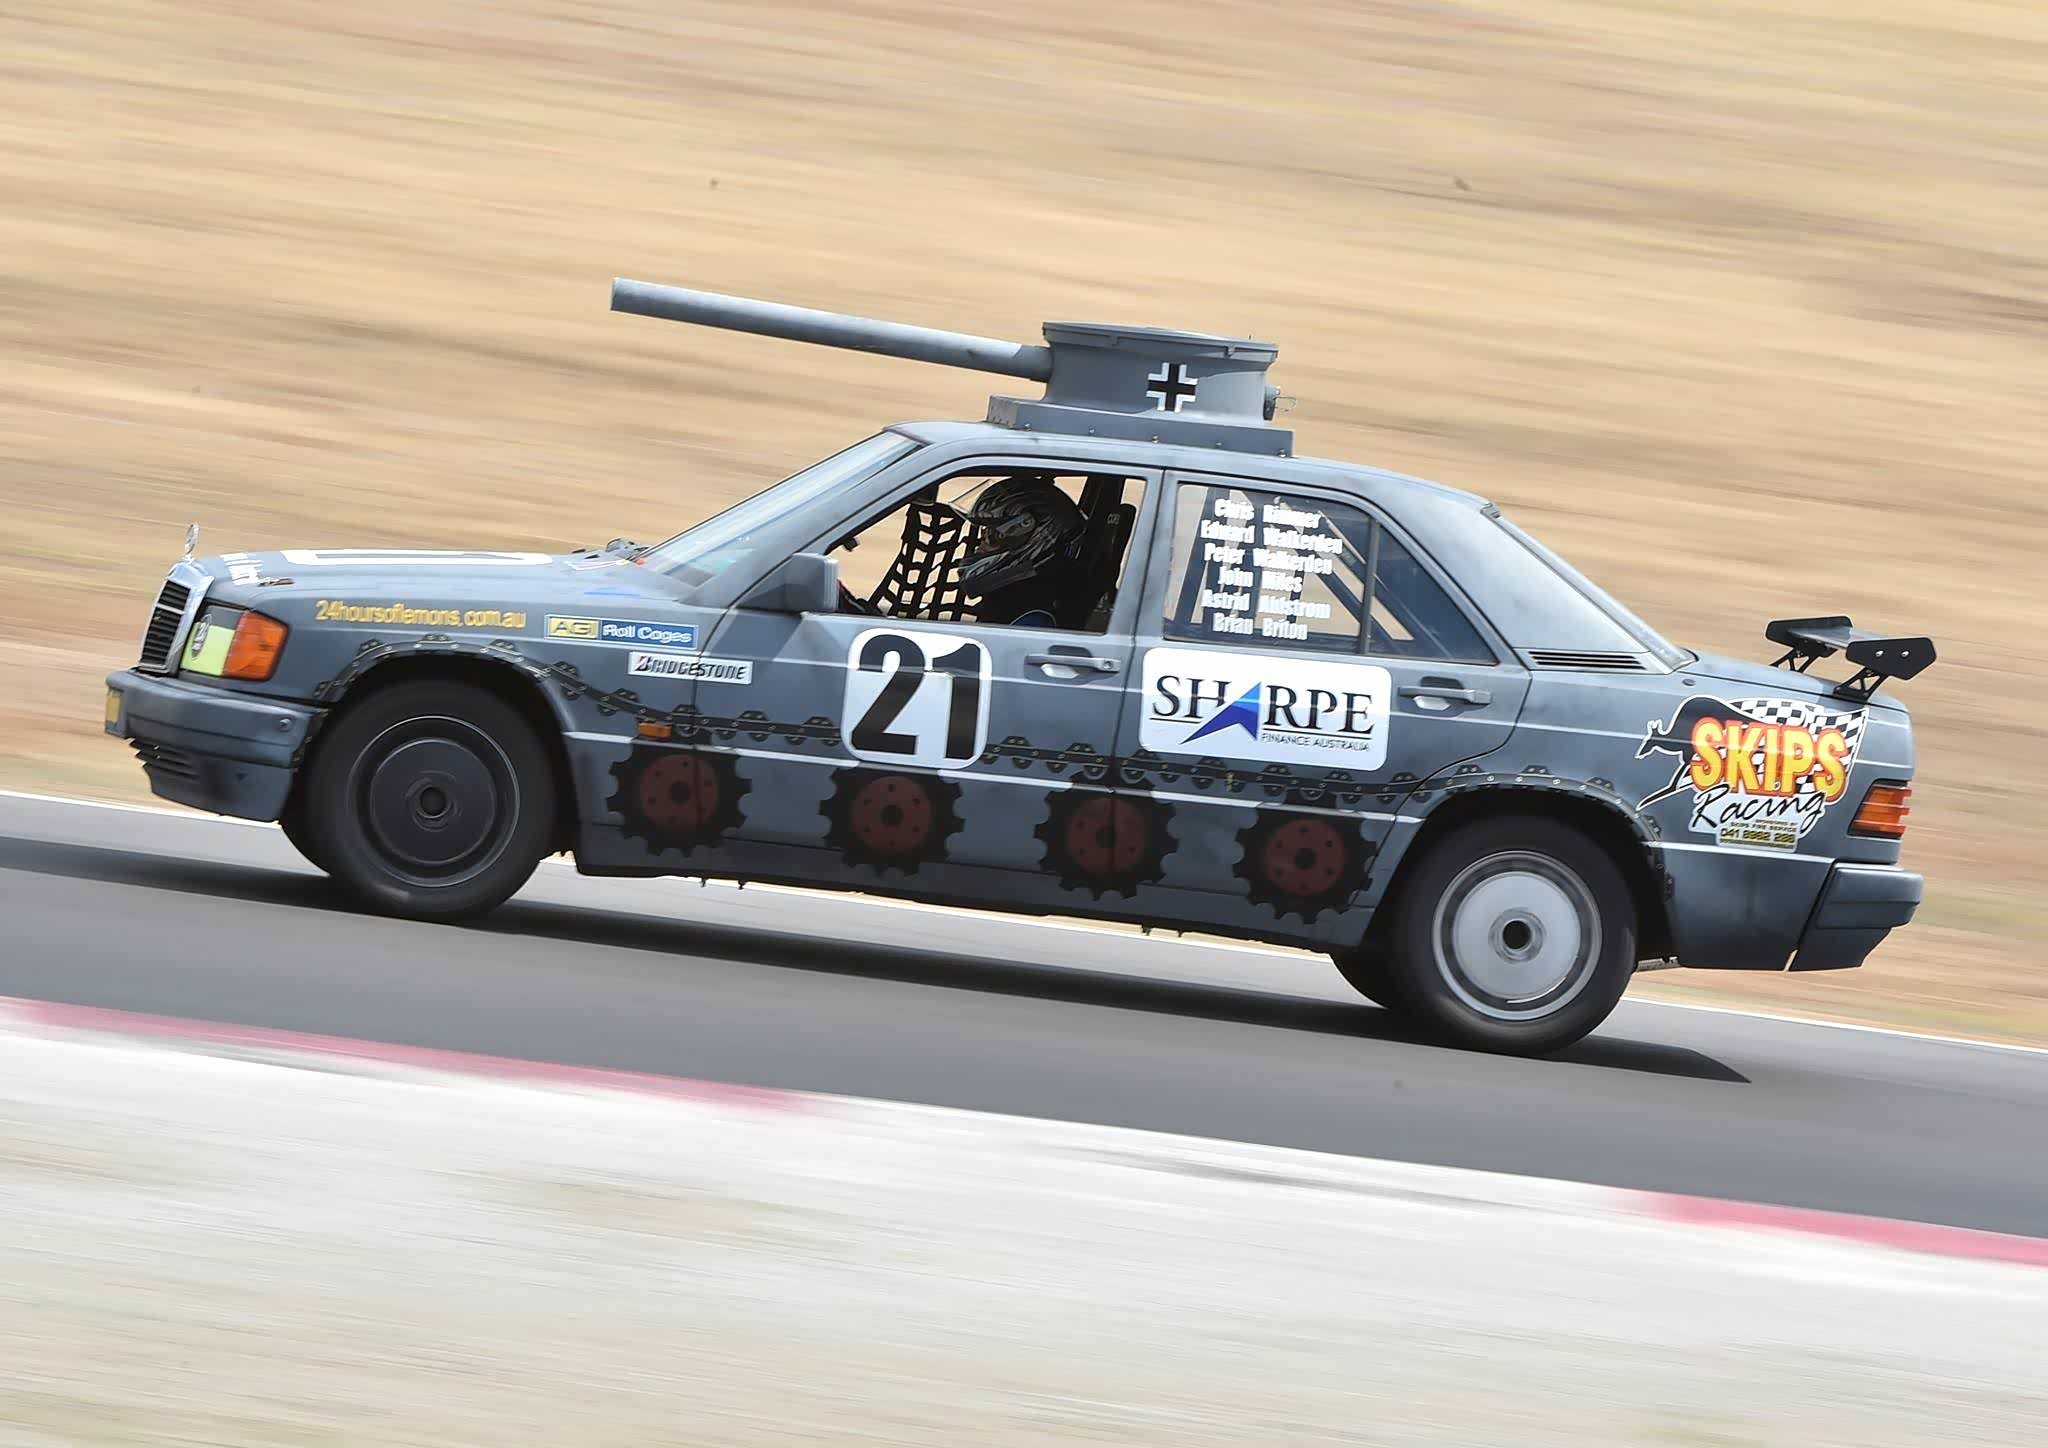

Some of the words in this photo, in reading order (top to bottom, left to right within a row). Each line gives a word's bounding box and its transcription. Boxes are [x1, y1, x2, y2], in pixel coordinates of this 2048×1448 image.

[1204, 543, 1245, 564] Peter
[315, 599, 527, 628] 24hoursoflemons.com.au
[602, 624, 635, 638] Roll
[637, 626, 692, 644] Cages
[635, 656, 747, 680] BRIDGESTONE
[850, 633, 982, 761] 21
[1152, 673, 1374, 744] SHARPE
[1261, 732, 1311, 746] FINANCE
[1690, 716, 1848, 801] SKIPS
[1692, 783, 1826, 833] Racing
